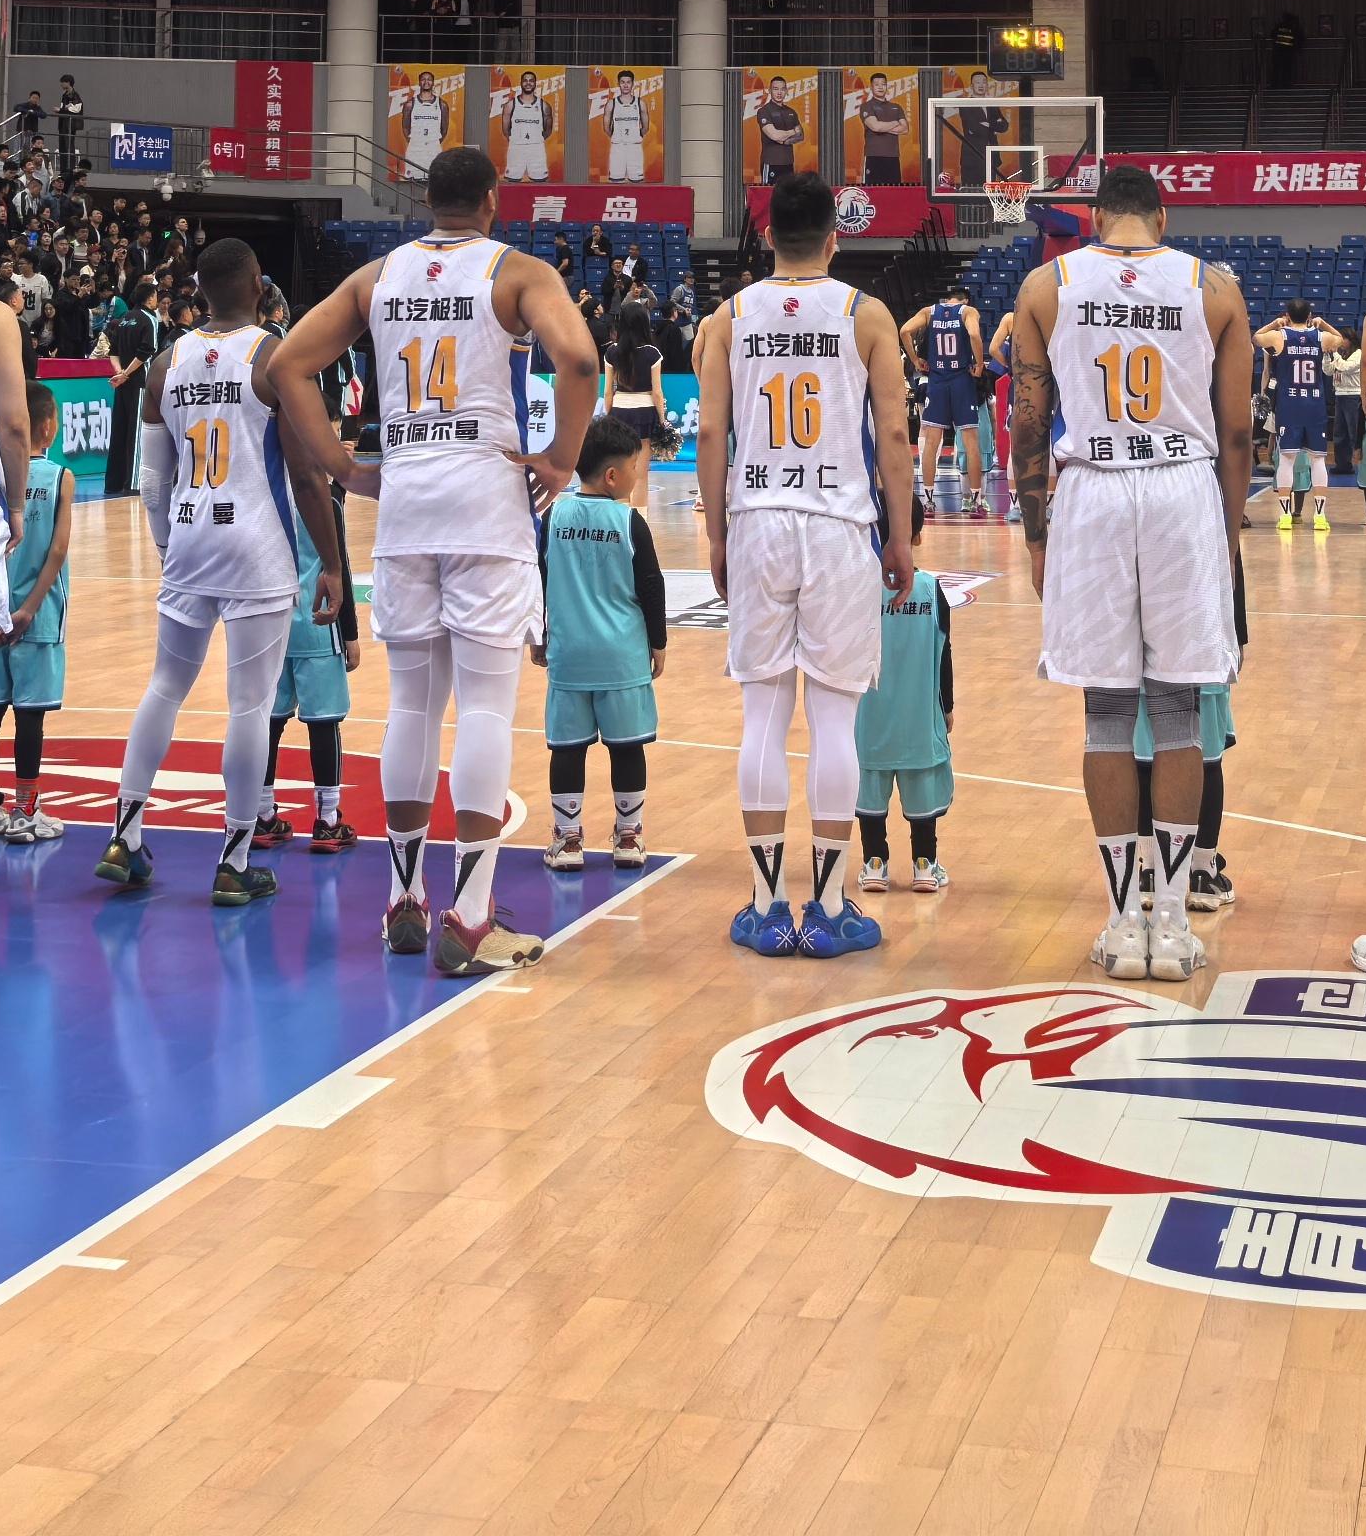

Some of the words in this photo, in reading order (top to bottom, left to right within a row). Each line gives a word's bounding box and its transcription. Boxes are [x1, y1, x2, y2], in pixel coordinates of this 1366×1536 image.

[388, 73, 465, 119] EGLES
[490, 74, 566, 119] EGLES
[588, 74, 664, 120] EGLES
[743, 74, 818, 121] EGLES
[843, 71, 919, 121] EGLES
[265, 65, 282, 171] 久实融资租赁
[137, 136, 171, 150] 安全出口
[143, 151, 165, 160] EXIT
[213, 141, 246, 160] 6号门
[532, 195, 637, 223] 青岛
[383, 295, 475, 323] 北汽极狐
[1077, 301, 1184, 332] 北汽极狐
[743, 332, 841, 360] 北汽极狐
[936, 333, 957, 356] 10
[398, 335, 459, 413] 14
[1094, 343, 1163, 424] 19
[1293, 360, 1315, 384] 16
[170, 380, 242, 408] 北汽极狐
[529, 400, 549, 419] 寿
[759, 371, 822, 451] 16
[63, 399, 112, 454] 跃动
[386, 419, 479, 444] 斯佩尔曼
[185, 417, 231, 490] 10
[1088, 432, 1189, 464] 塔瑞克
[745, 464, 840, 491] 张才仁
[177, 502, 236, 526] 杰曼
[556, 526, 621, 544] 动小雄鹰
[881, 601, 932, 616] 小雄鹰
